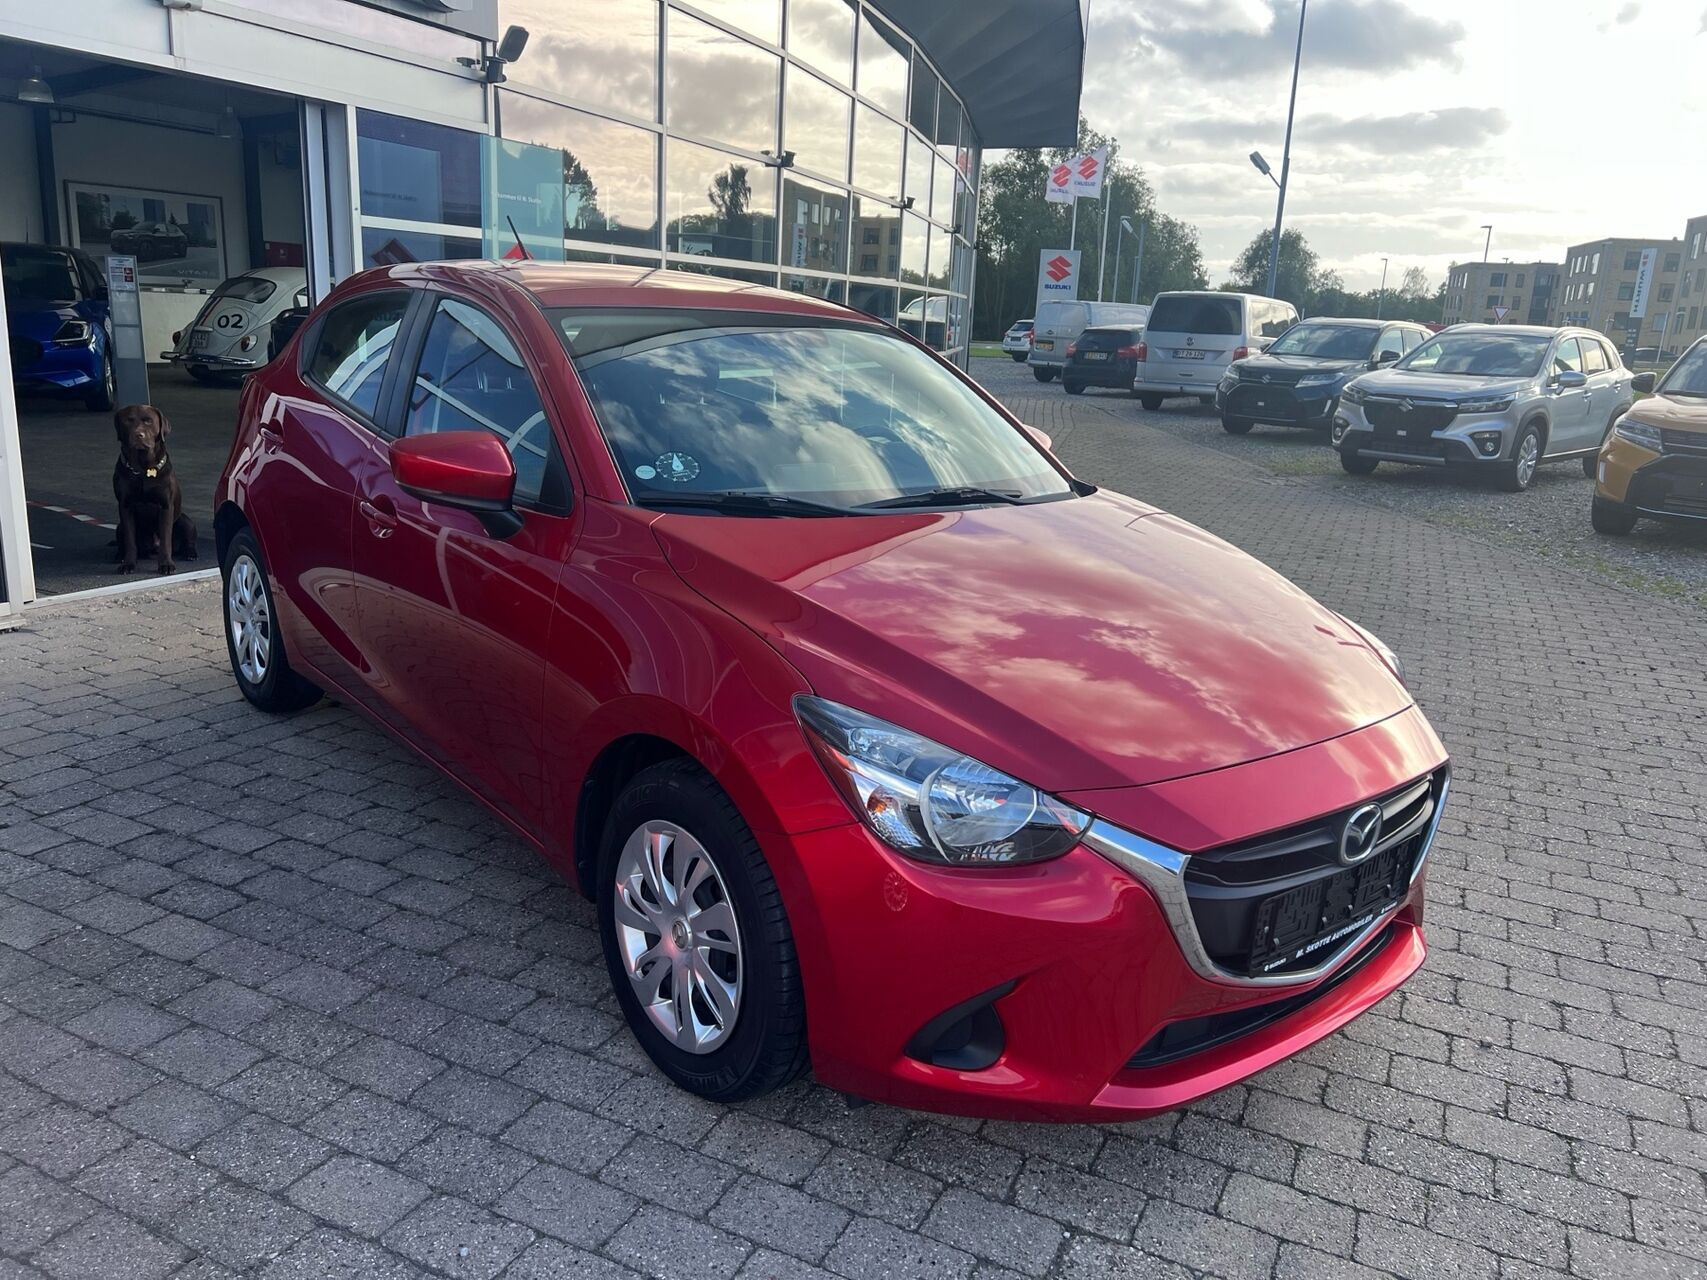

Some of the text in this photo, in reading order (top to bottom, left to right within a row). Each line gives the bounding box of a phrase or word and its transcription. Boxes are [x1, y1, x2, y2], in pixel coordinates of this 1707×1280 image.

[217, 313, 243, 329] 02
[1305, 935, 1332, 953] SKOTTE
[1331, 914, 1374, 941] AUTOMOBILER
